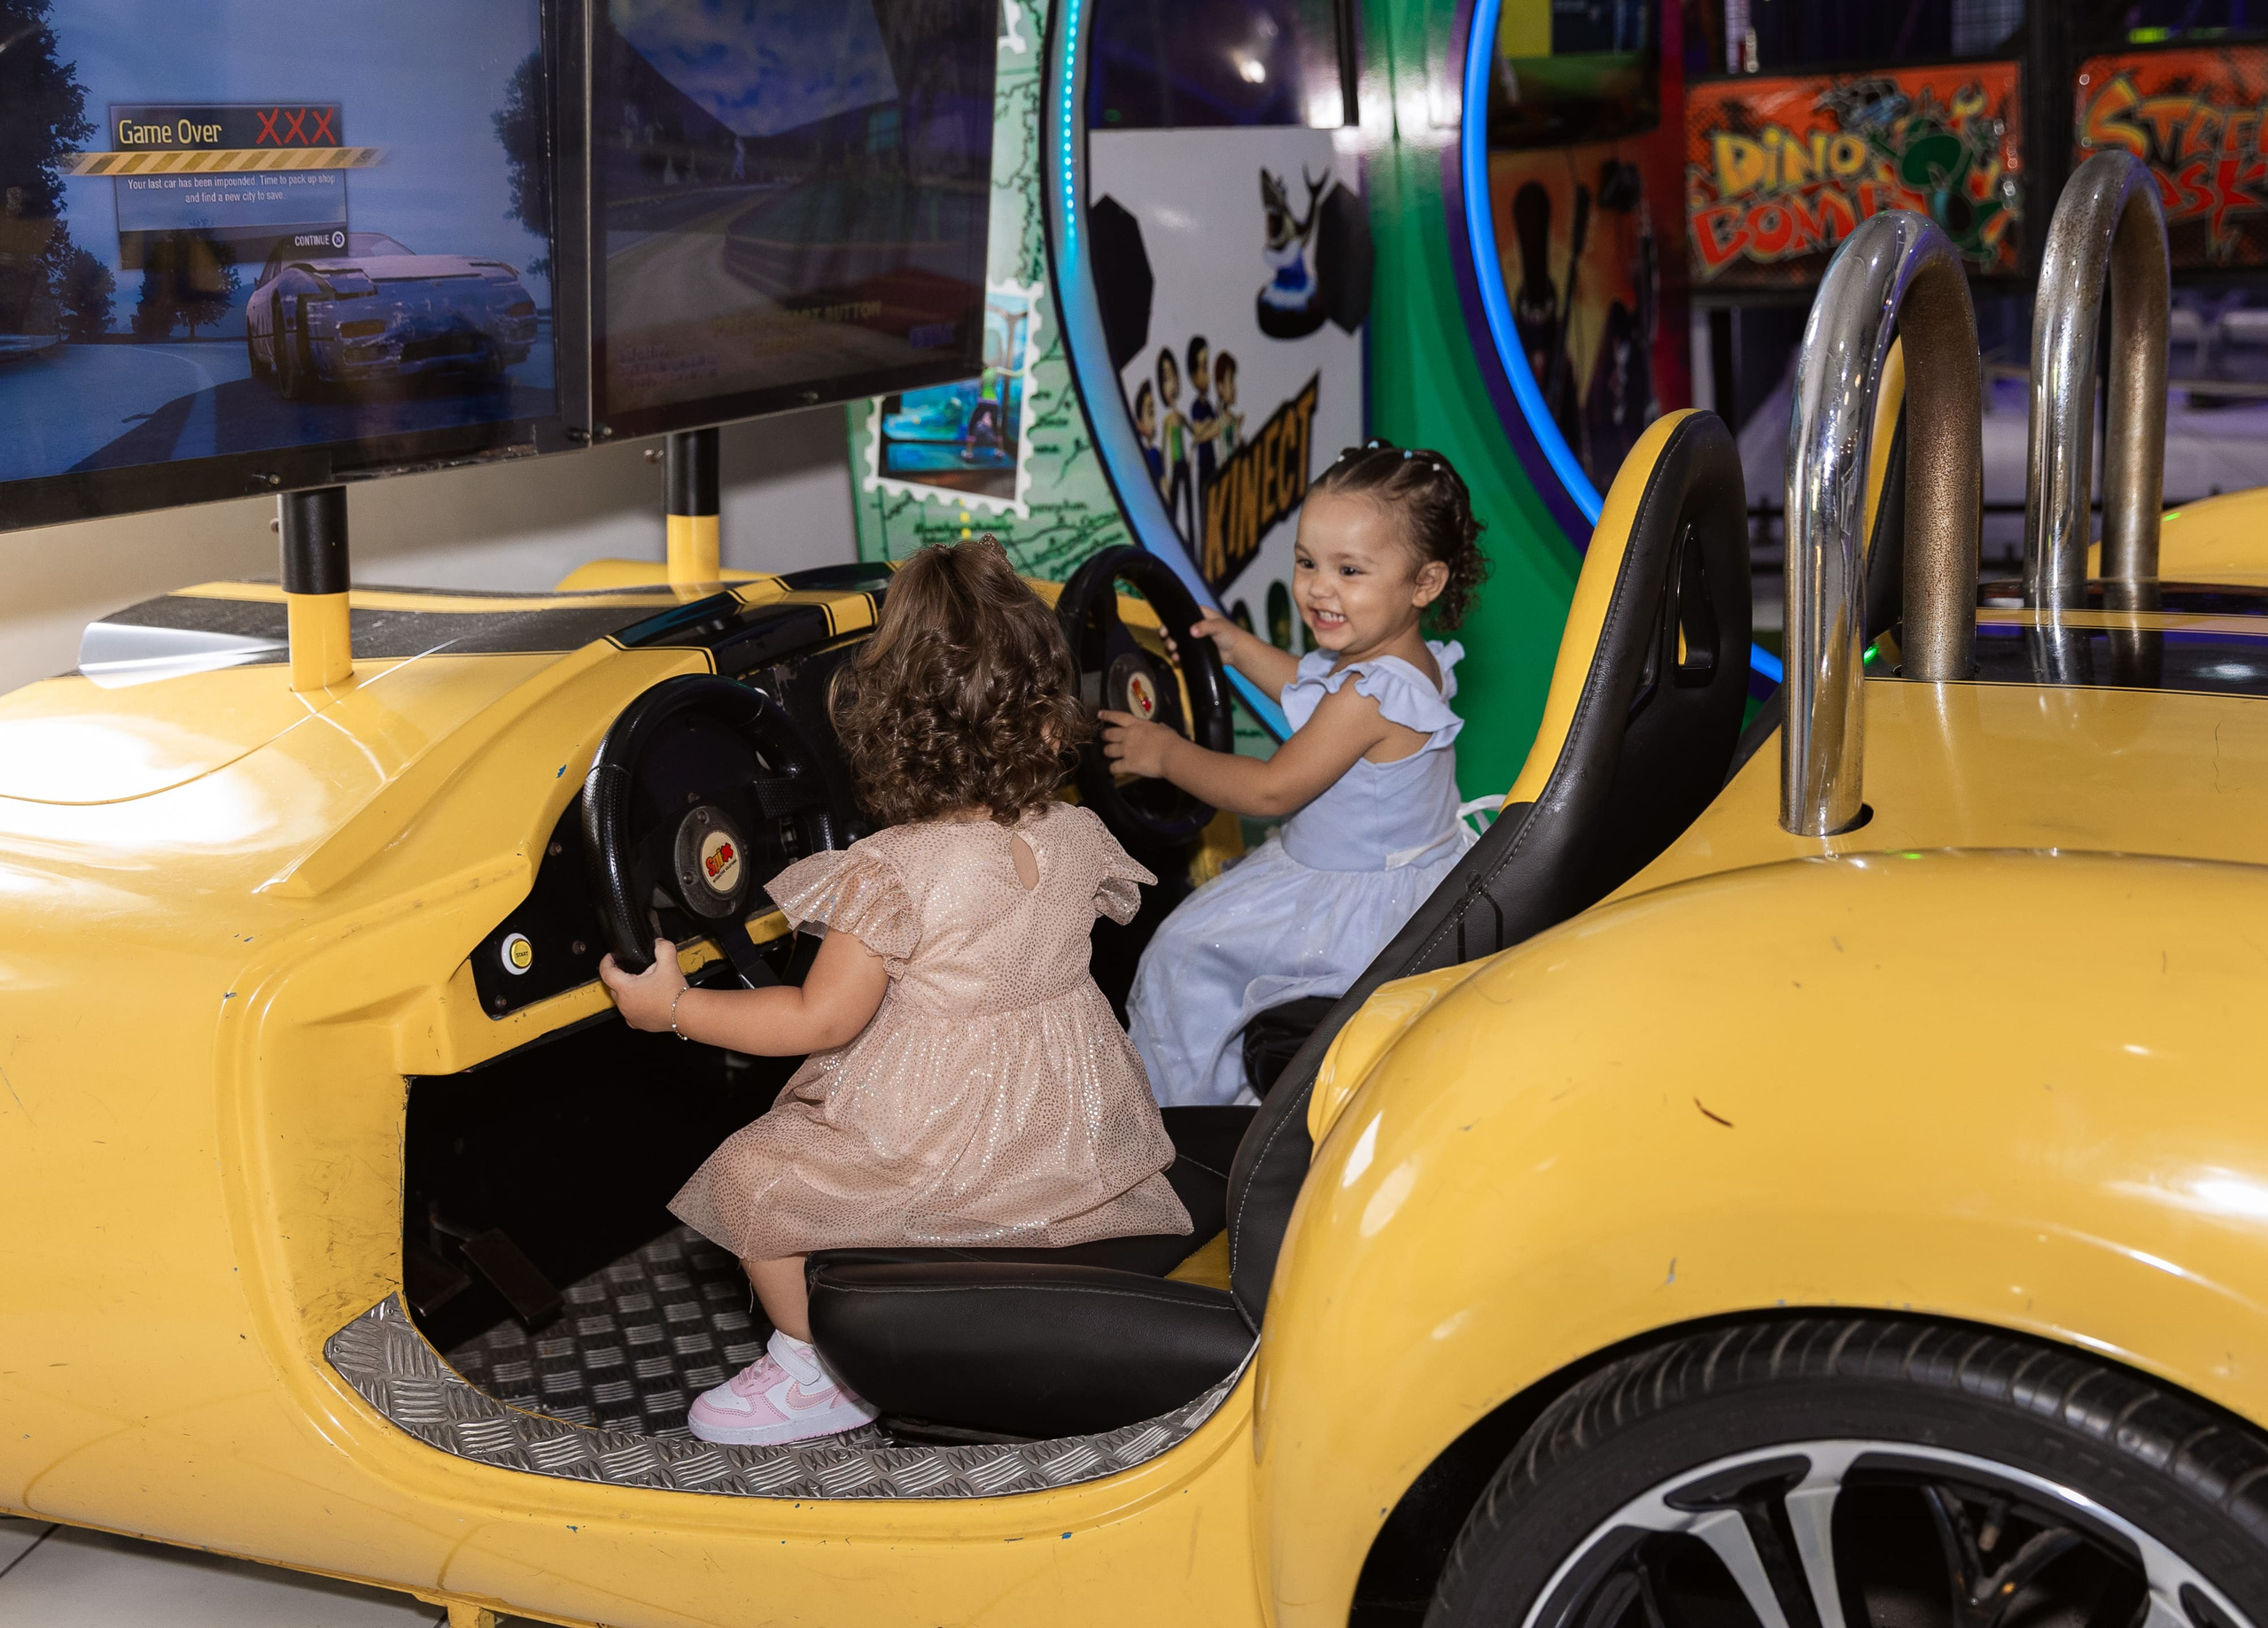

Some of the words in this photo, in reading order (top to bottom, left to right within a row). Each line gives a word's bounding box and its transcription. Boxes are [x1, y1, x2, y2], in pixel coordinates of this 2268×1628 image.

[119, 119, 172, 144] Game
[178, 119, 221, 144] Over
[128, 179, 147, 190] Your
[148, 178, 162, 189] last
[178, 178, 192, 188] has
[194, 177, 213, 188] been
[260, 174, 277, 185] Time
[279, 175, 287, 185] to
[289, 174, 306, 186] pack
[307, 175, 316, 185] up
[318, 174, 335, 185] shop
[185, 193, 200, 203] and
[201, 192, 216, 202] find
[243, 191, 256, 203] city
[294, 235, 330, 246] CONTINUE
[1202, 383, 1318, 586] KINECT
